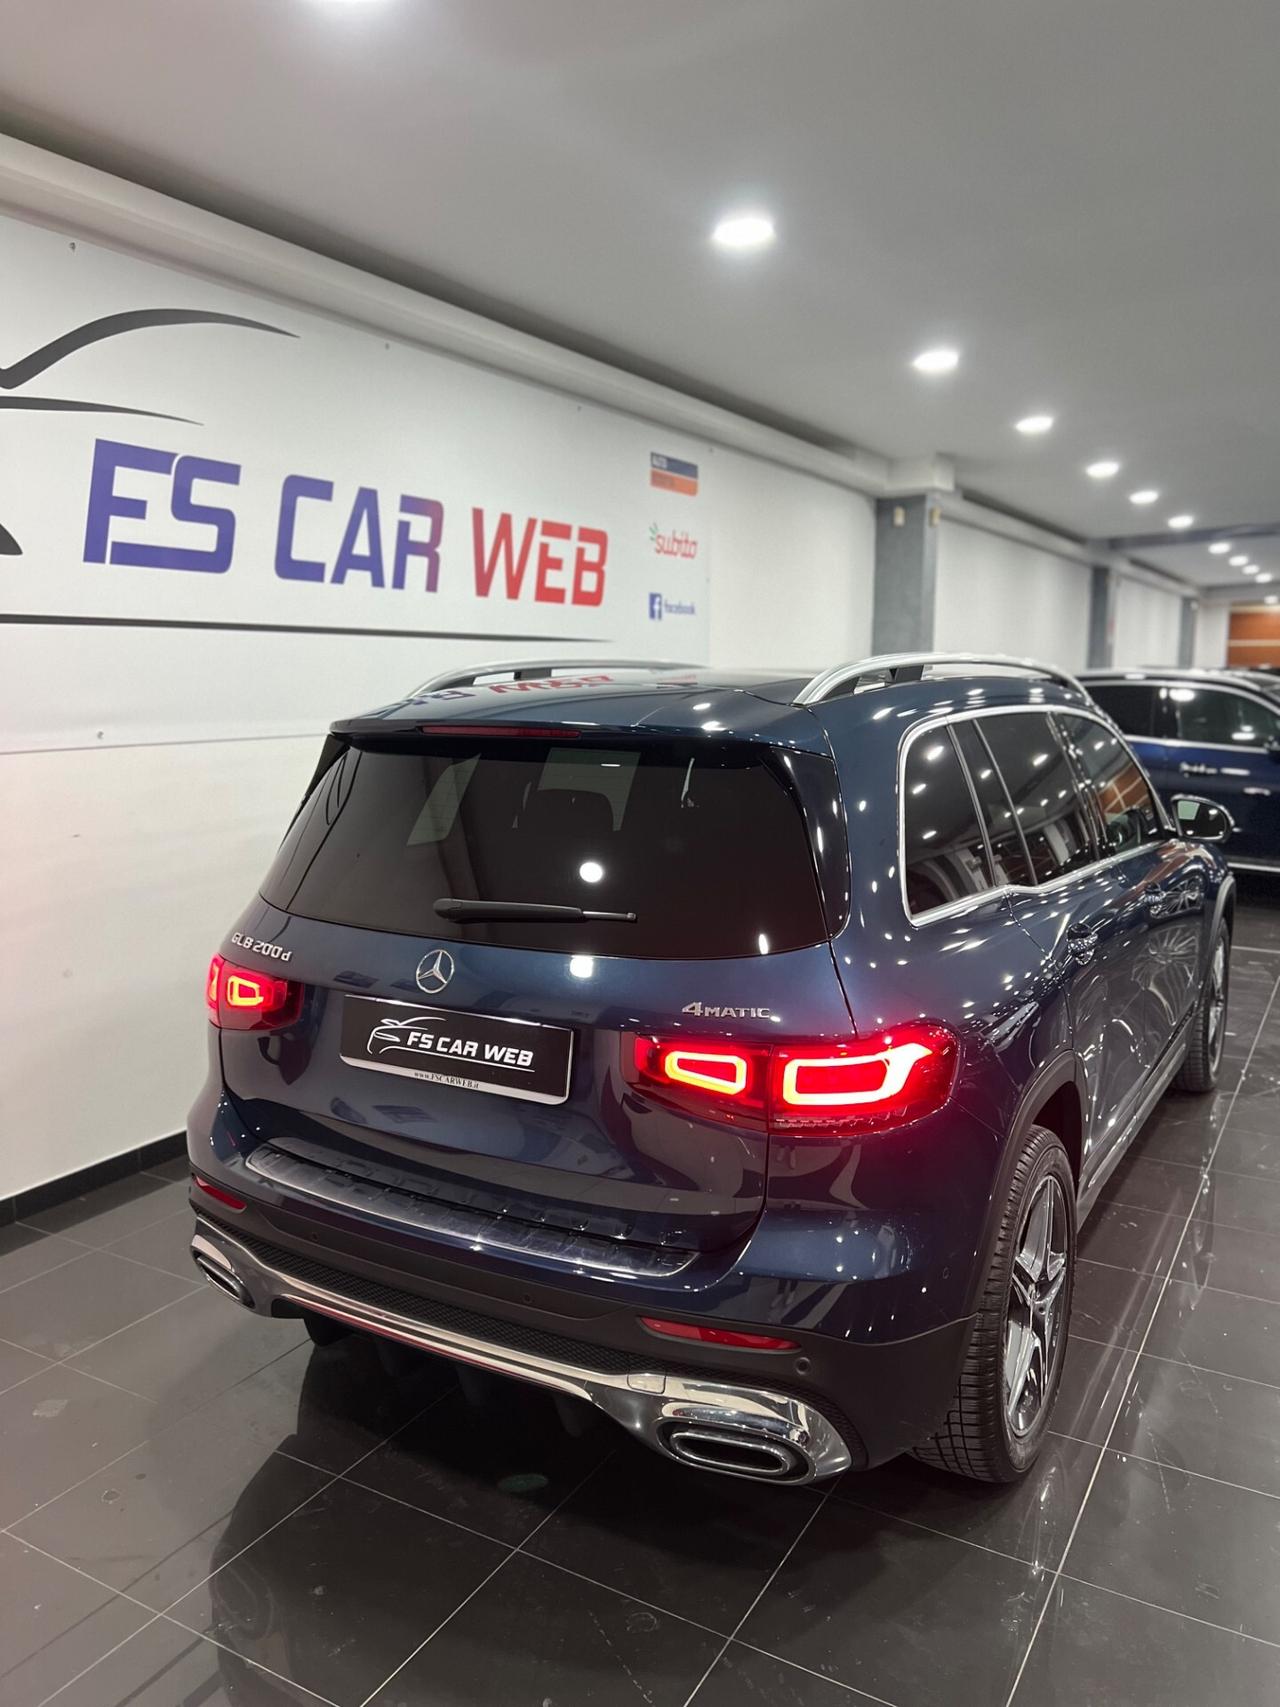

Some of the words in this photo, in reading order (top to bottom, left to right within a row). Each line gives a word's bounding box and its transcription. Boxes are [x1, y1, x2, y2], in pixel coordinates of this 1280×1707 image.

[83, 438, 242, 574] FS
[274, 473, 445, 593] CAR
[471, 506, 609, 607] WEB
[655, 529, 698, 559] subito
[231, 932, 254, 949] GLB
[682, 1001, 770, 1018] 4MATIC
[406, 1031, 434, 1050] FS
[436, 1036, 479, 1058] CAR
[484, 1043, 535, 1068] WEB
